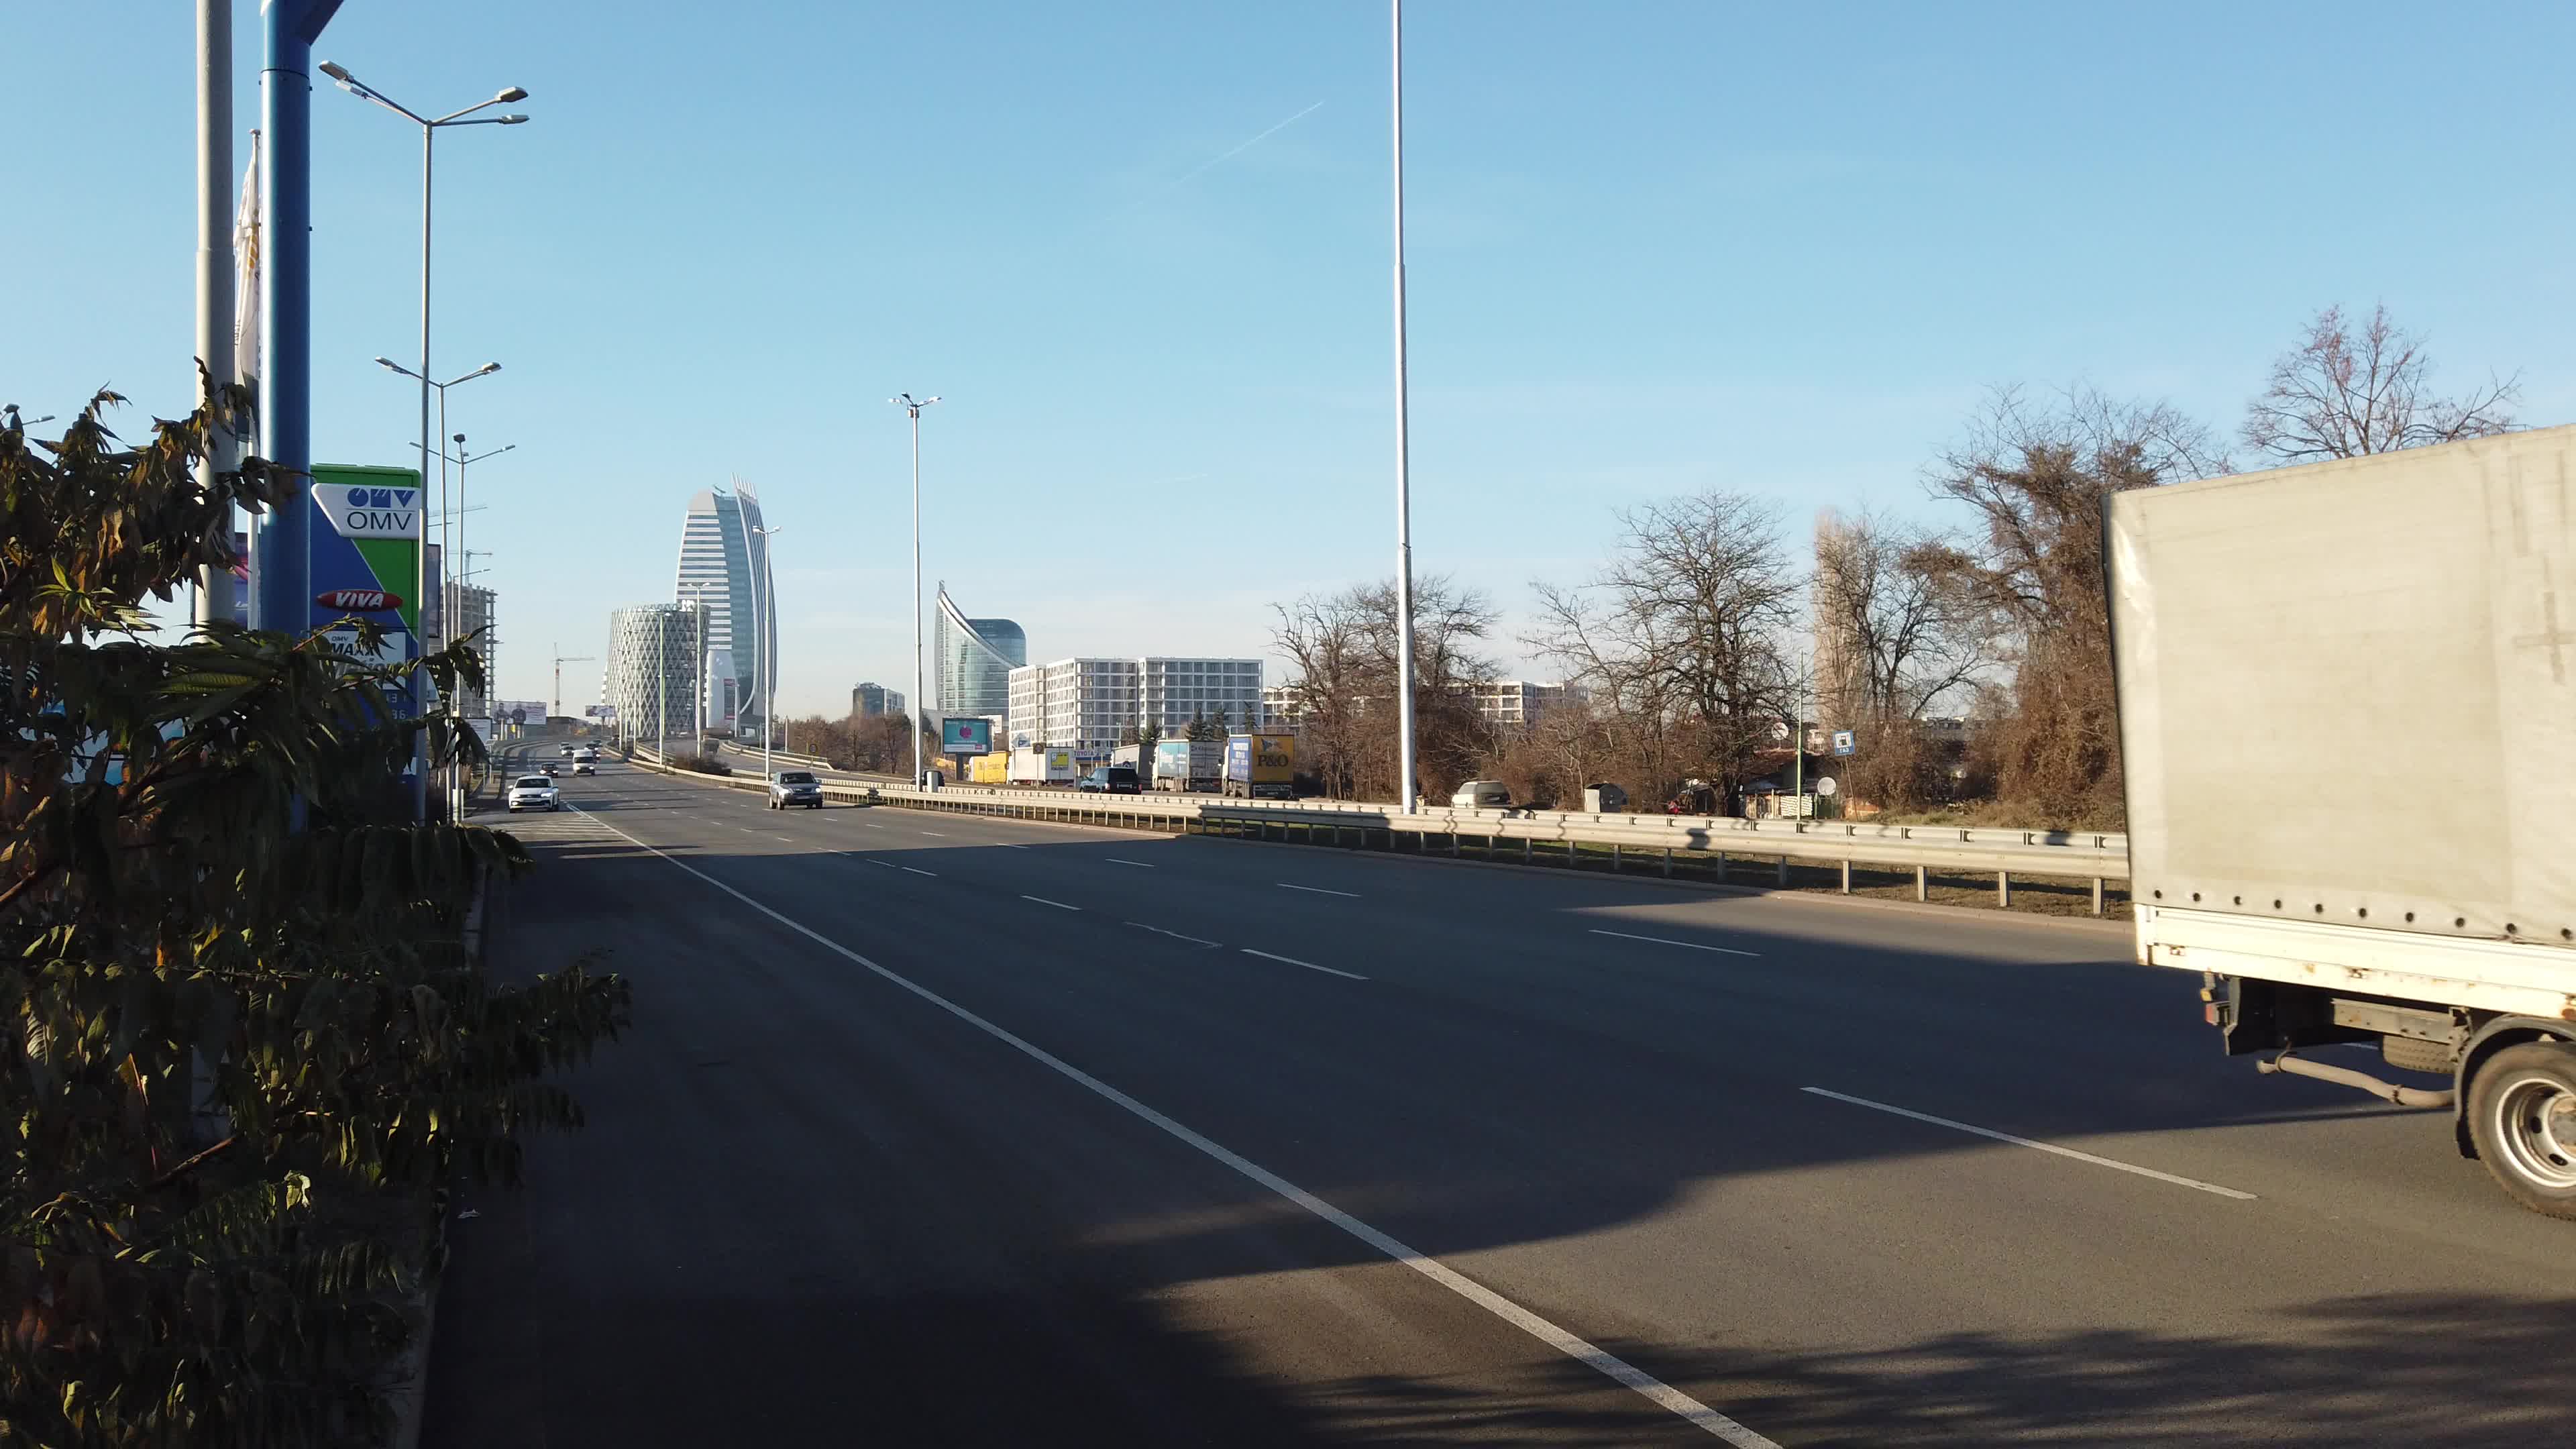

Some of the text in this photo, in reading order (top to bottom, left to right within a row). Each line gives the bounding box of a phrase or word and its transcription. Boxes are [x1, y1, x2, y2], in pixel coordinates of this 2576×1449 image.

[347, 511, 413, 530] OMV
[335, 591, 384, 607] VIVA
[1258, 753, 1289, 767] P&O
